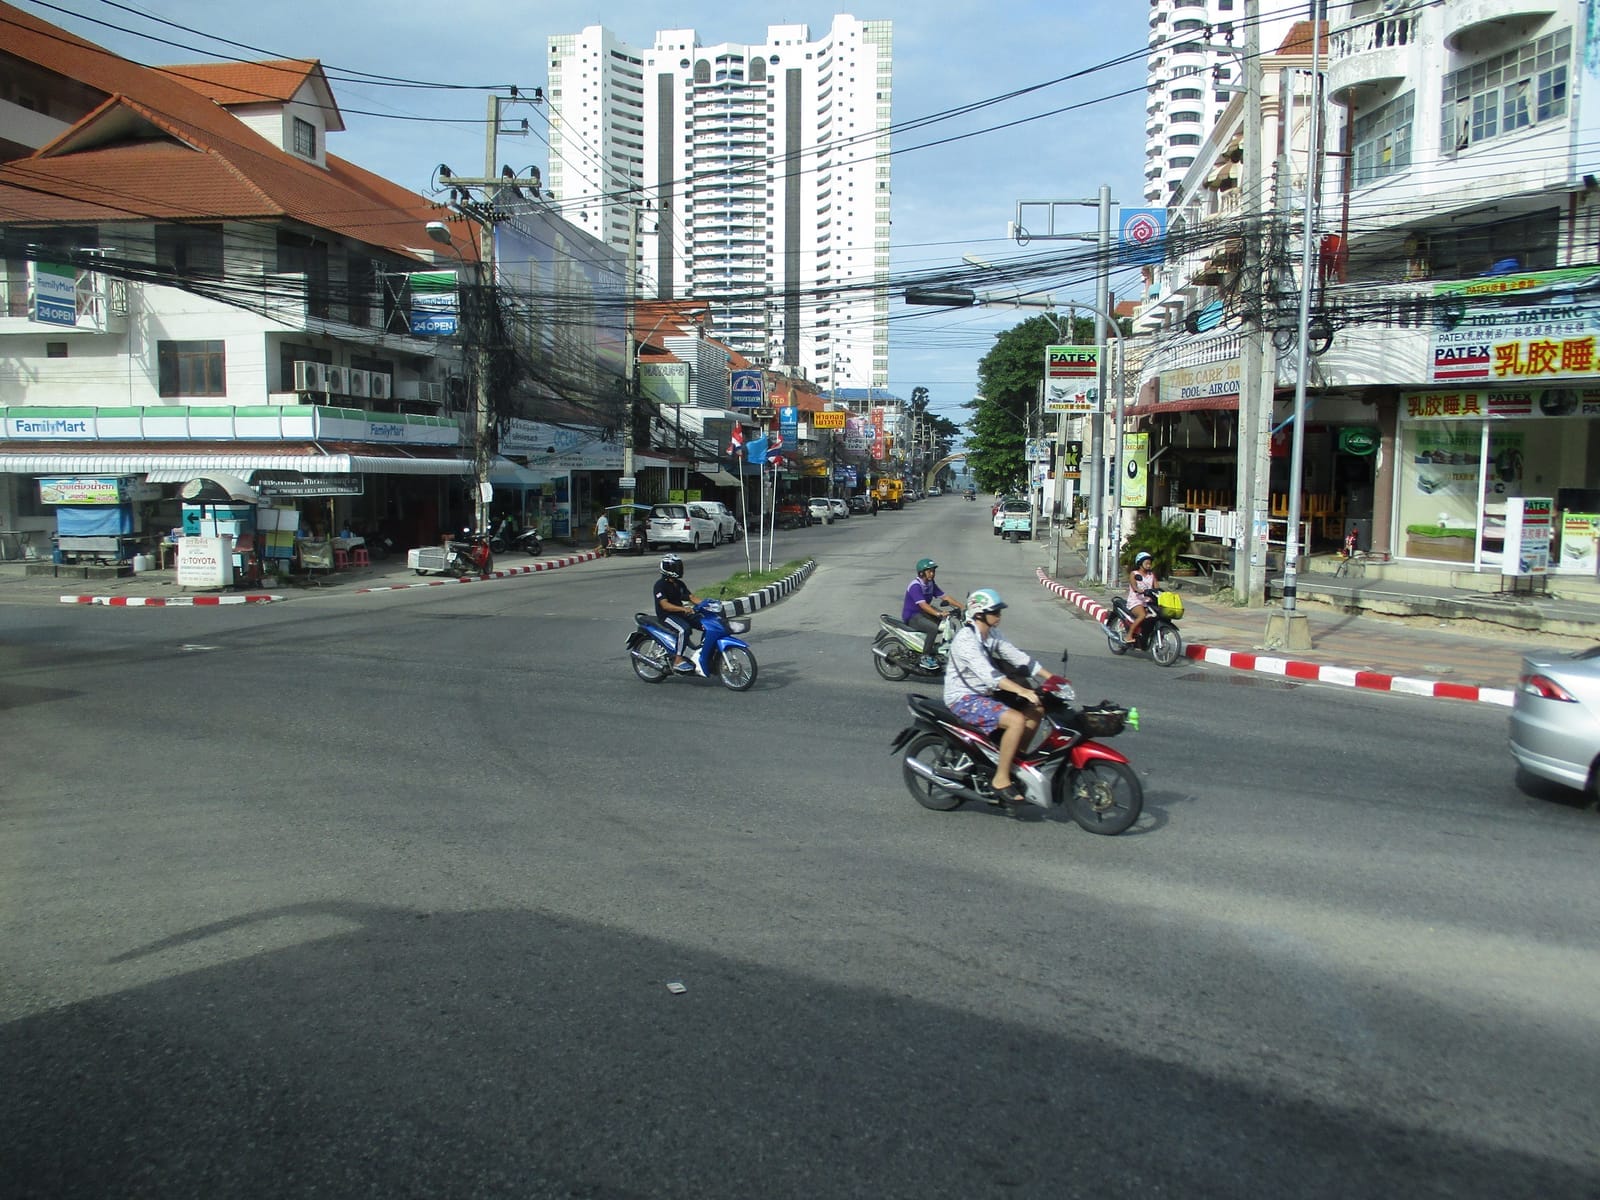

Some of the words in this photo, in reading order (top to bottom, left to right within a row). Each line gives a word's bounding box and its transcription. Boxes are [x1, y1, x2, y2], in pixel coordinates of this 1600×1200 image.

[36, 277, 75, 293] FamilyMart
[39, 306, 50, 318] 24
[51, 309, 75, 321] OPEN
[414, 322, 425, 331] 24
[426, 322, 453, 331] OPEN
[1049, 353, 1096, 362] PATEX
[1435, 345, 1490, 360] PATEX
[1494, 337, 1600, 377] 乳胶睡
[1196, 367, 1222, 384] CARE
[1181, 386, 1200, 398] POOL
[1488, 392, 1531, 402] PATEX
[1407, 394, 1480, 417] 乳胶睡具
[16, 420, 86, 435] FamilyMart
[370, 423, 404, 438] FamilyMart
[1524, 501, 1550, 511] PATEX
[189, 557, 216, 565] TOYOTA
